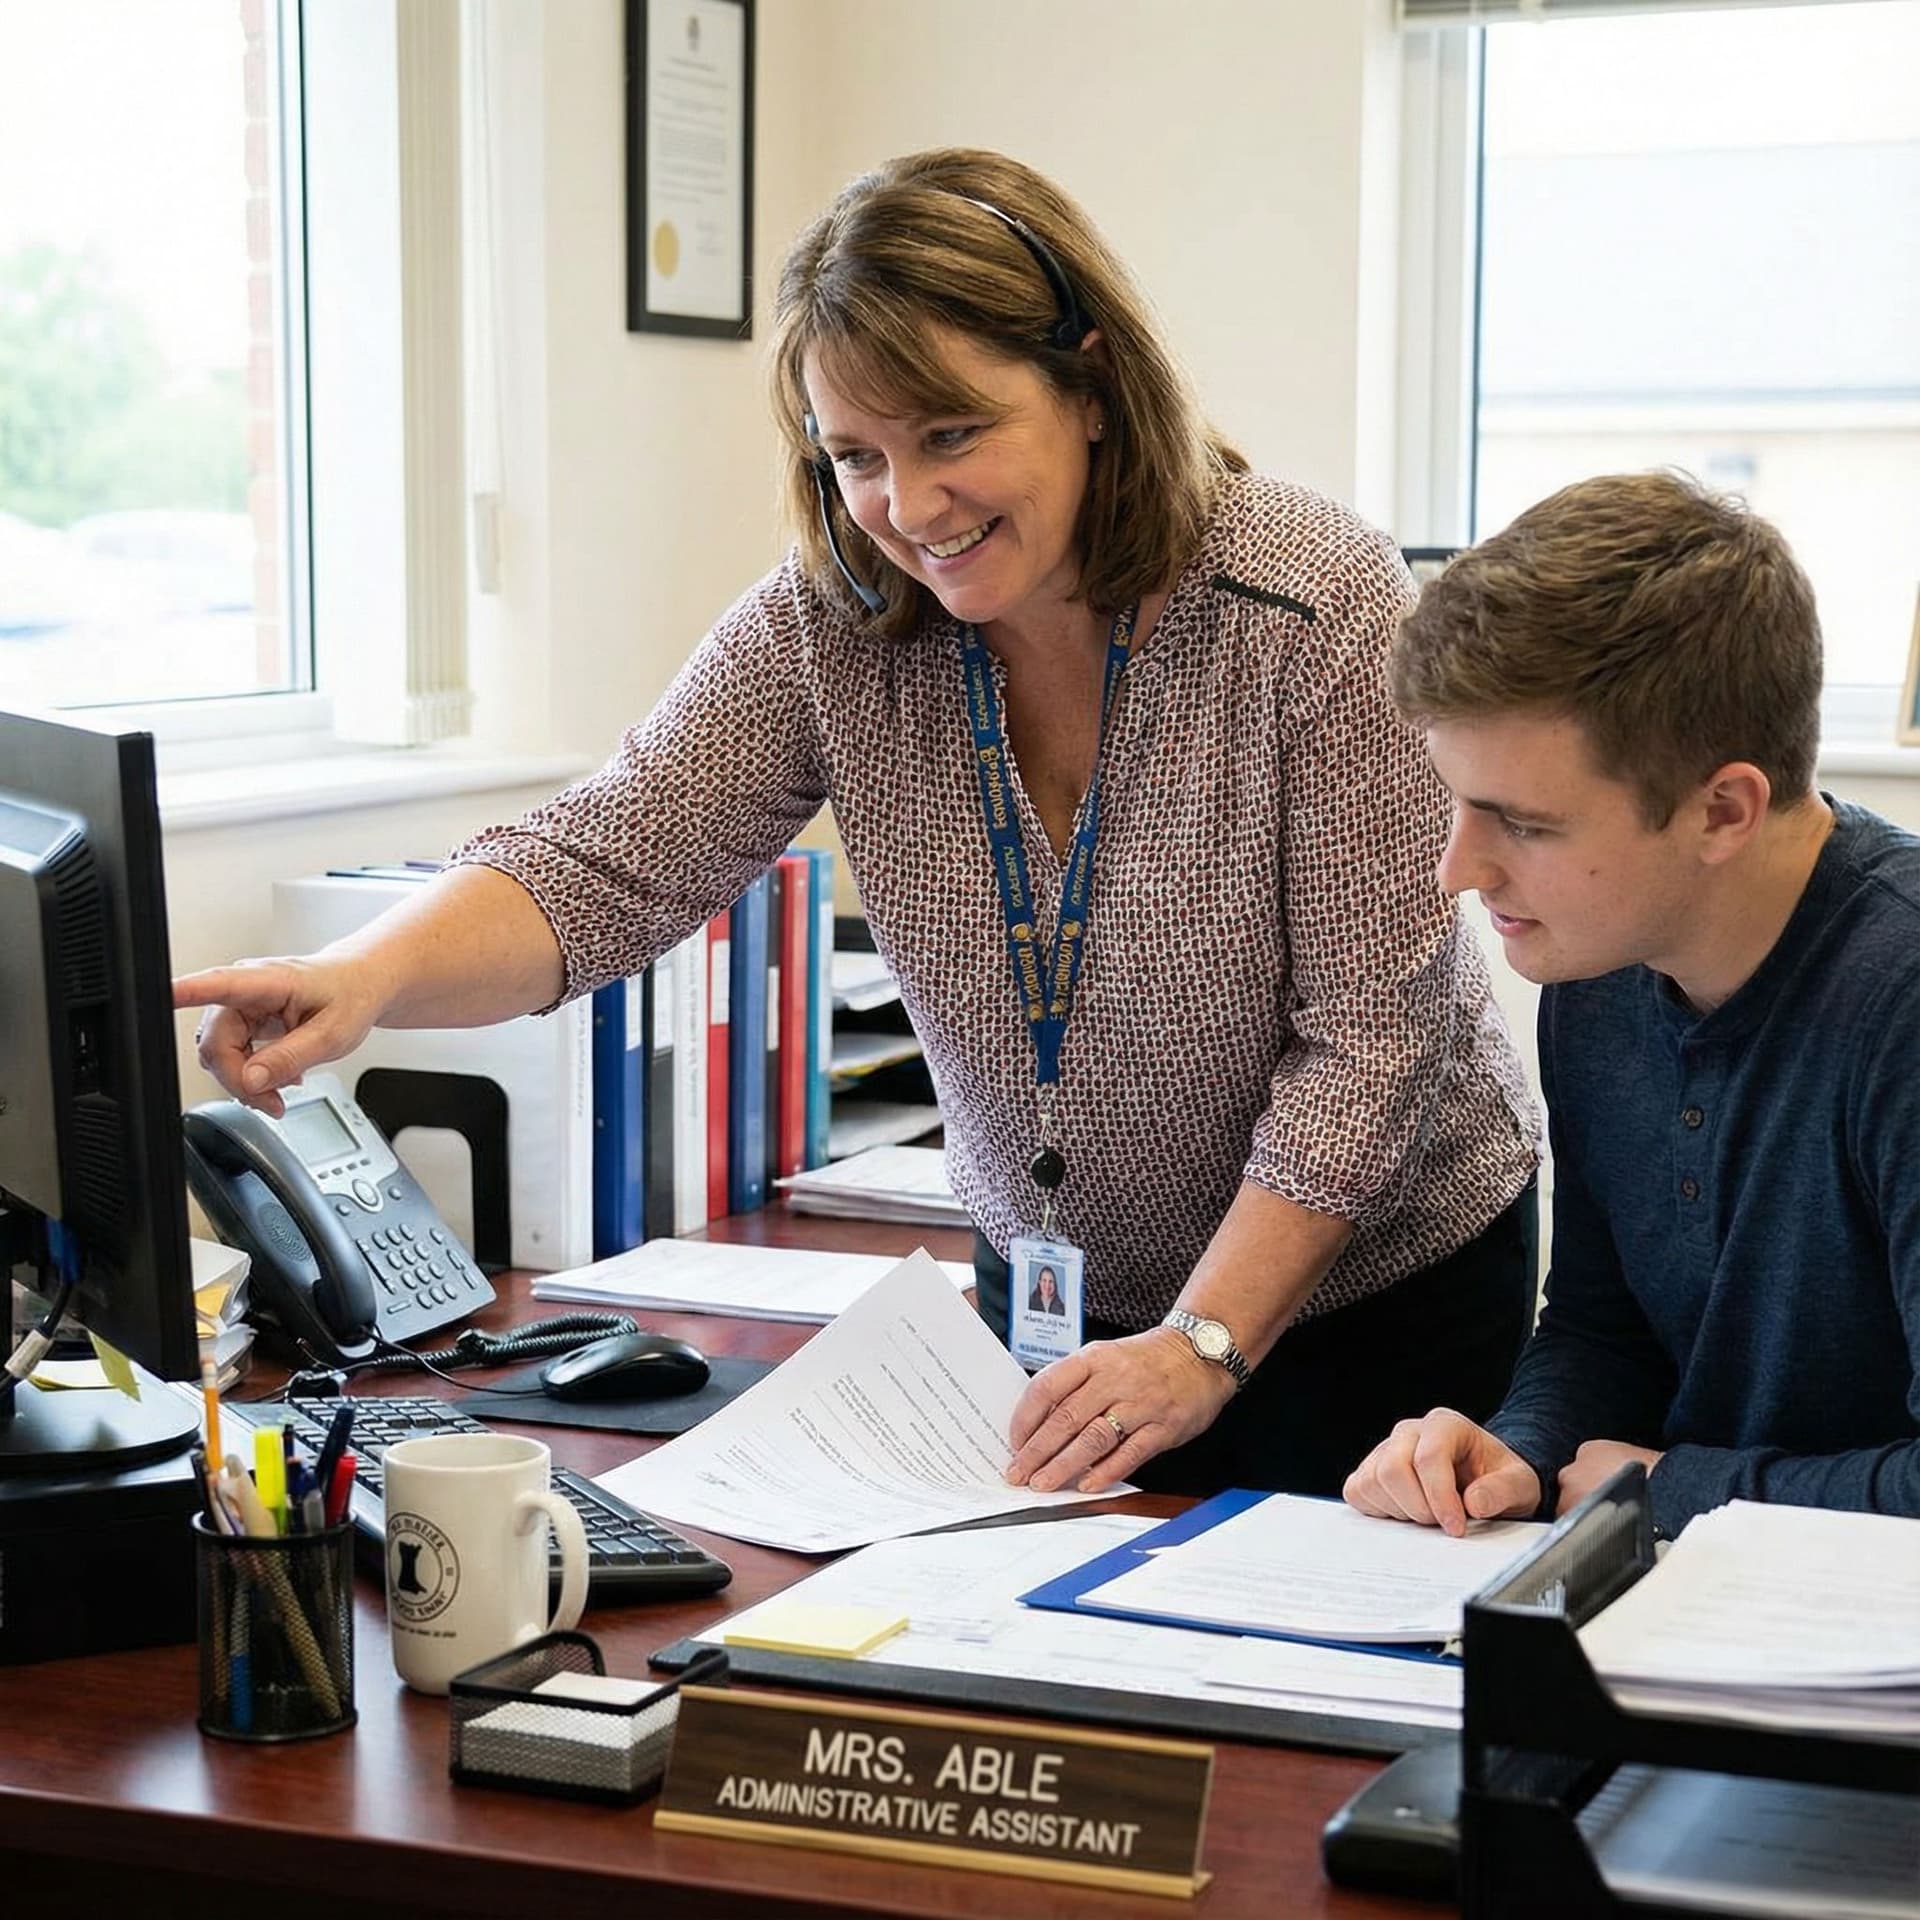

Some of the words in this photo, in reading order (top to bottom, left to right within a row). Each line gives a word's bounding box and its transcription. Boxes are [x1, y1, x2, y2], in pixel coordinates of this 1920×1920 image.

[804, 1728, 914, 1785] MRS.
[935, 1744, 1065, 1803] ABLE
[717, 1776, 960, 1836] ADMINISTRATIVE
[968, 1807, 1141, 1856] ASSISTANT
